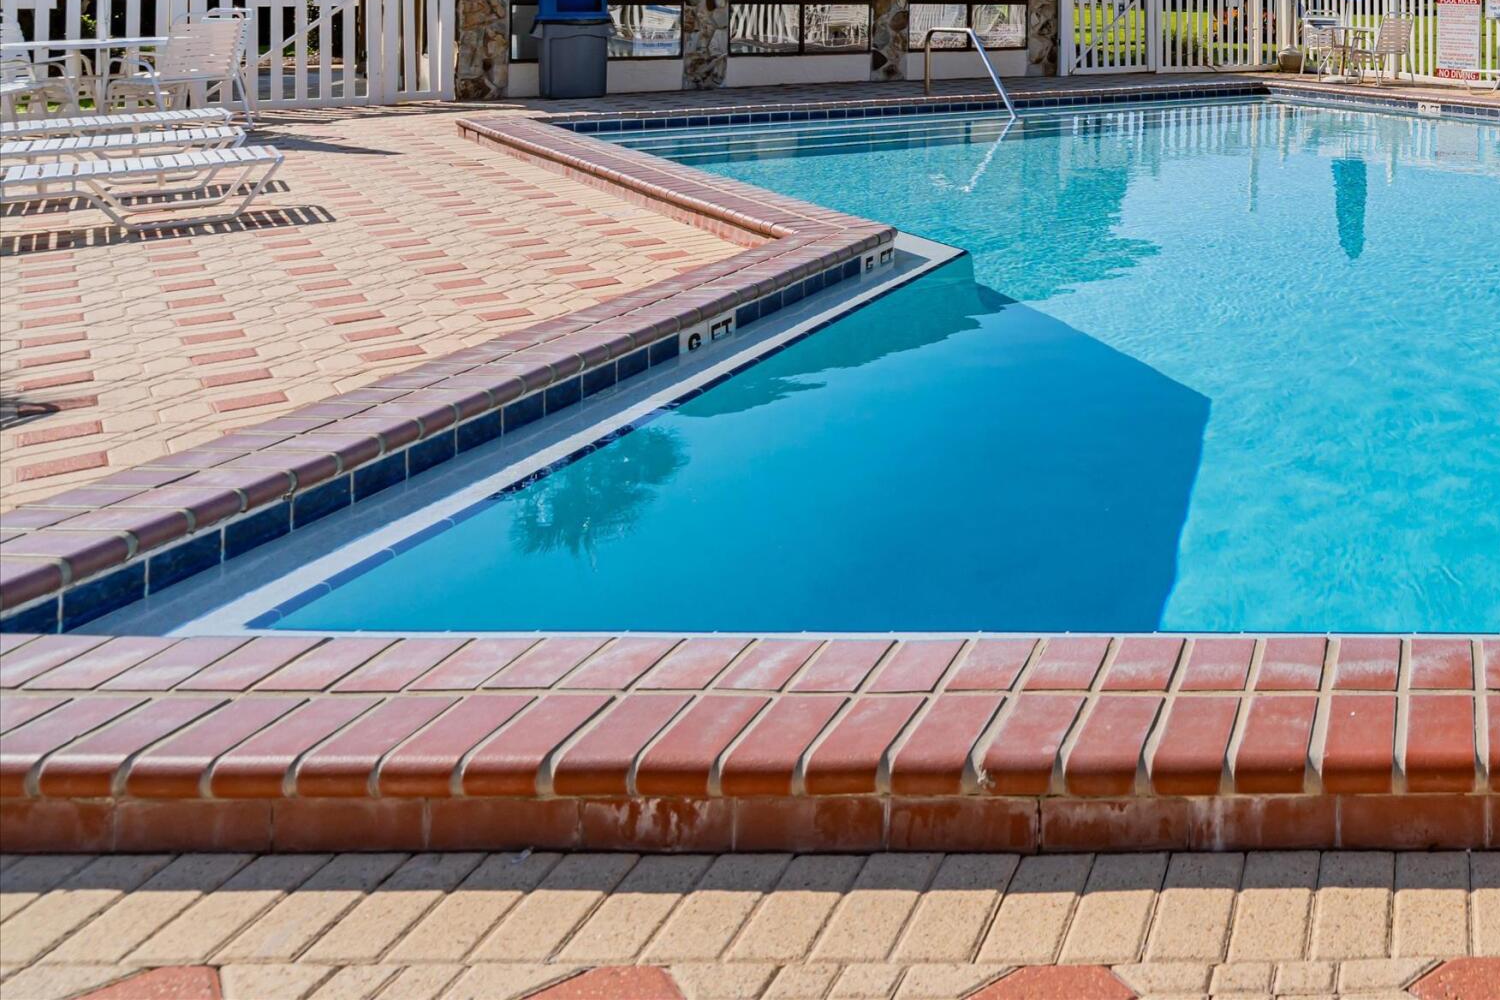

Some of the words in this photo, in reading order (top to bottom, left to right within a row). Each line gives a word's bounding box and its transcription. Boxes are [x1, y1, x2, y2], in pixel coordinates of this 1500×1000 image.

[1439, 69, 1450, 78] NO
[1451, 70, 1475, 80] DIVING
[711, 317, 732, 340] FT
